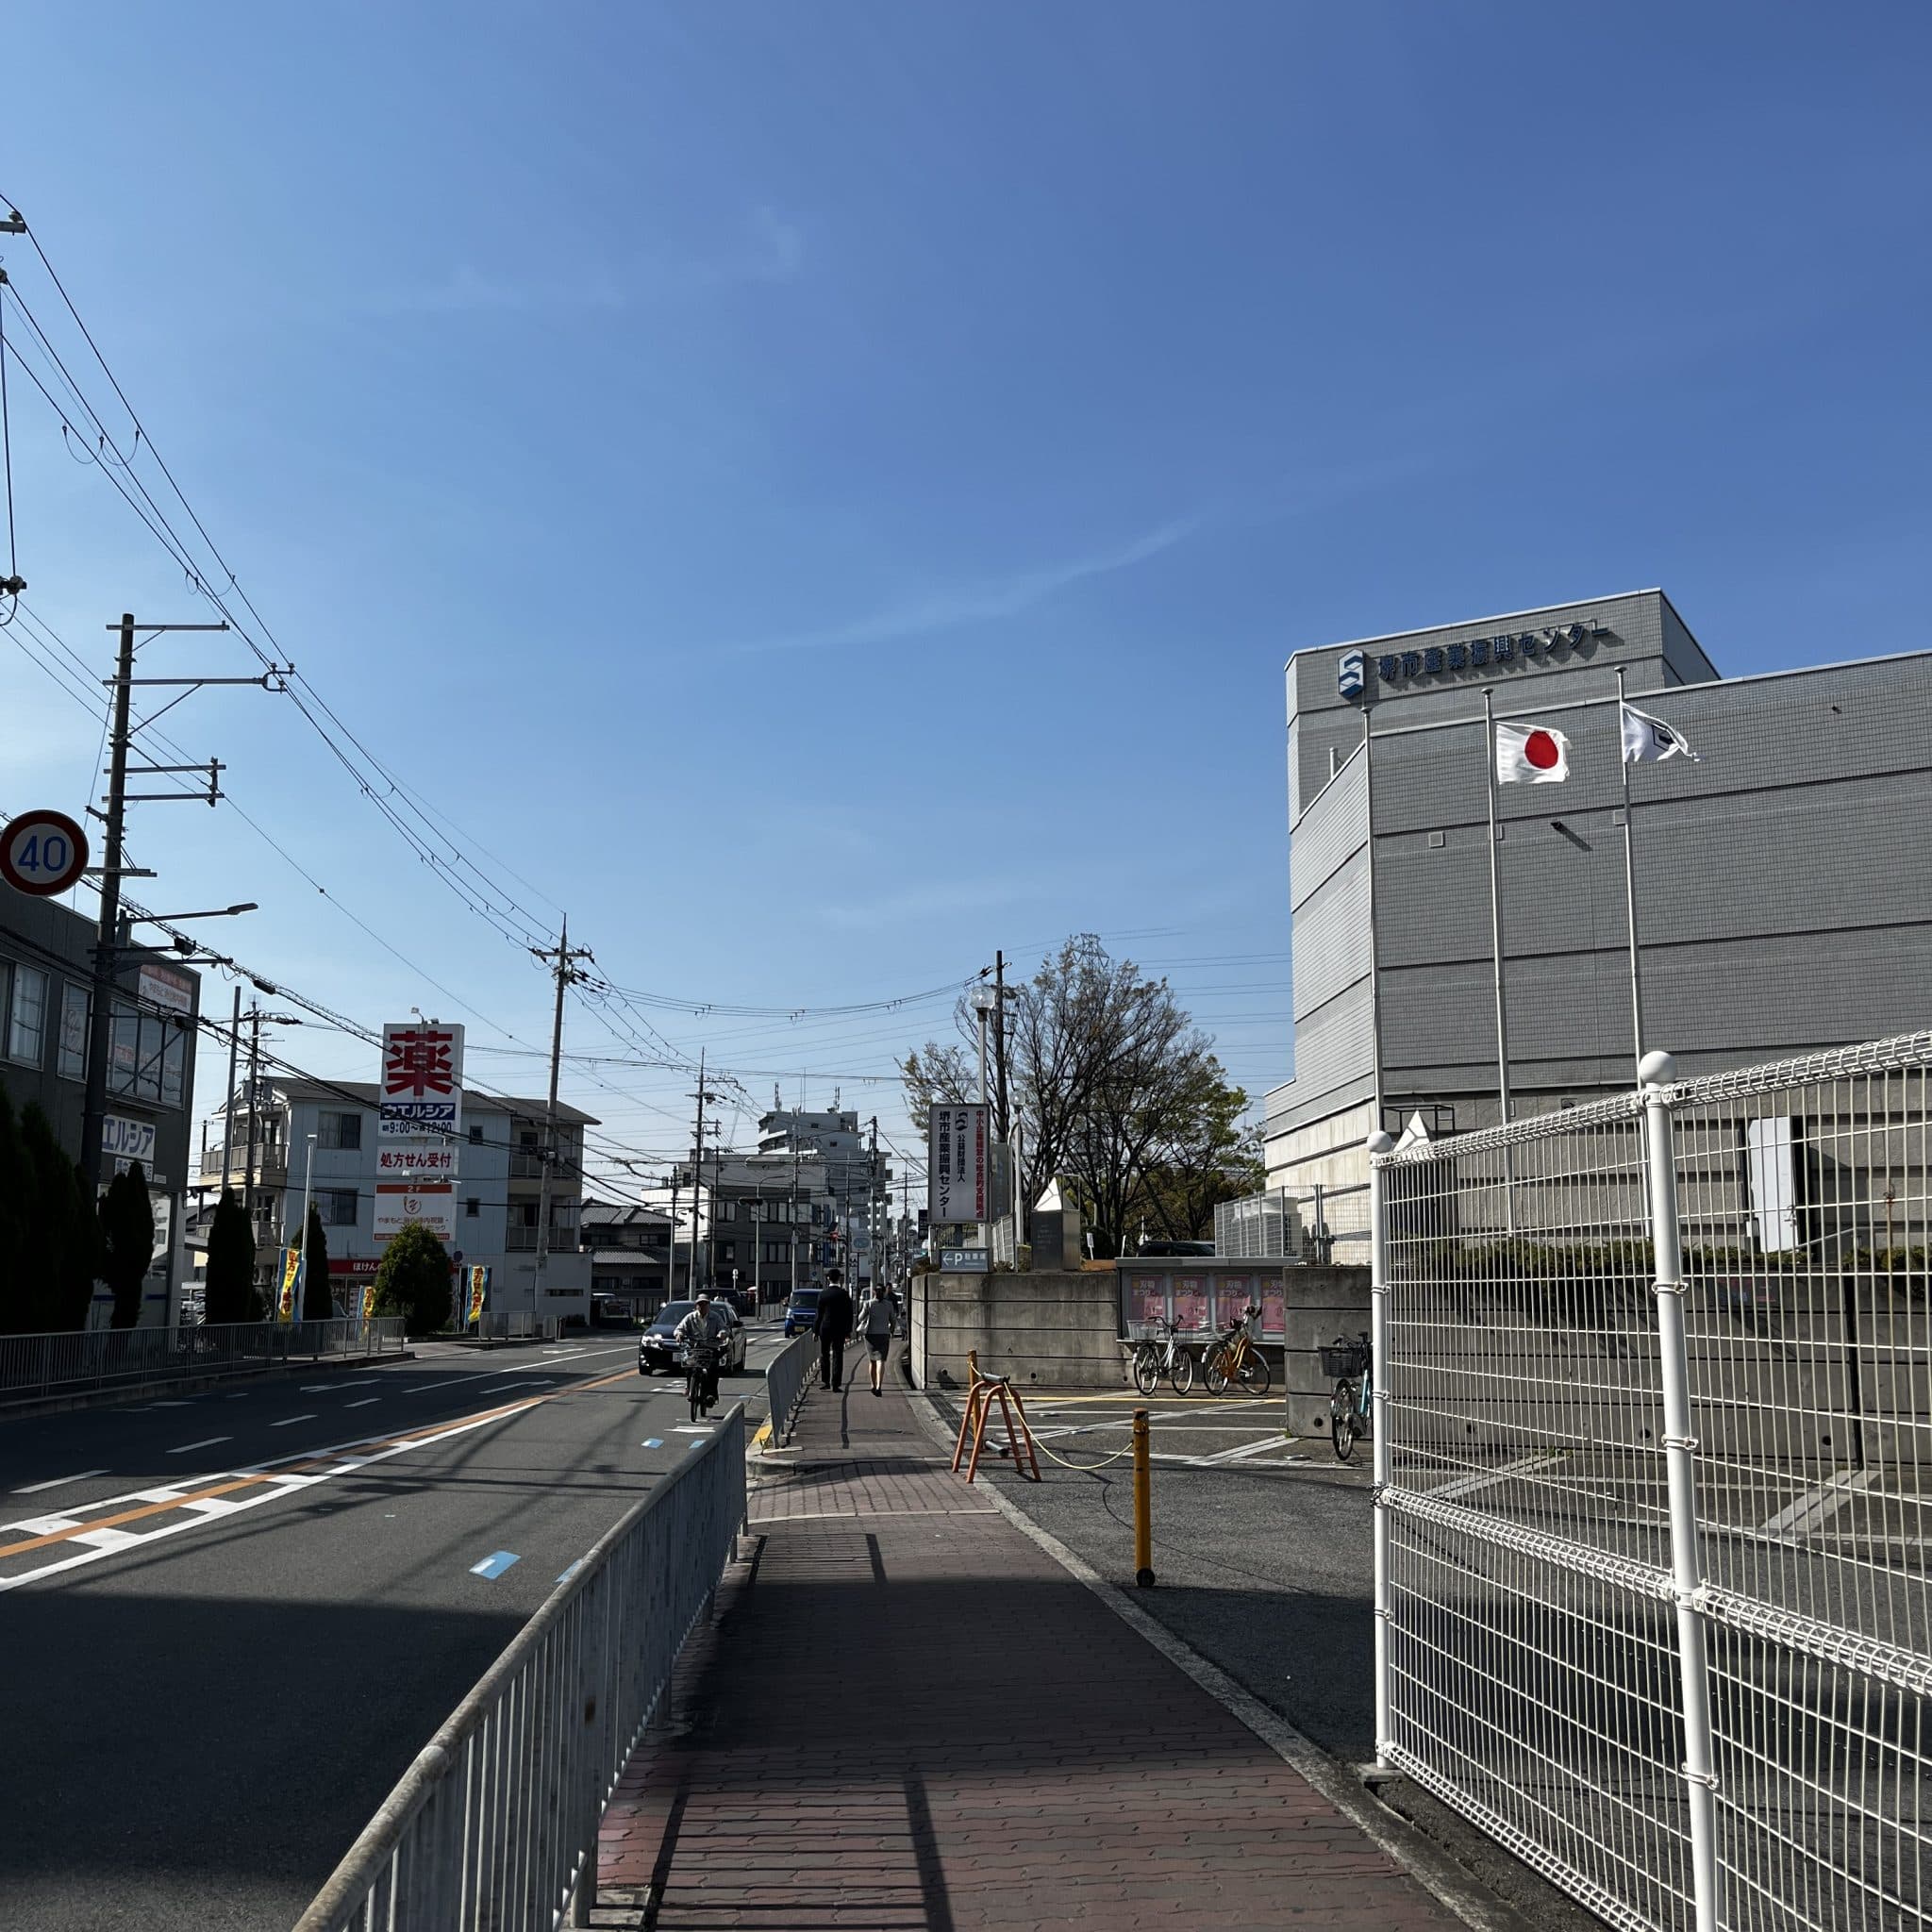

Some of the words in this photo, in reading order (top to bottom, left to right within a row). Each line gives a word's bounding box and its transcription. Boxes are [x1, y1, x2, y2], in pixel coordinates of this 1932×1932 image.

[1378, 624, 1608, 680] 堺市産業振興センター
[18, 835, 66, 872] 40
[385, 1030, 453, 1096] 薬
[102, 1118, 155, 1156] エルシア
[957, 1133, 966, 1183] 公益財団法人
[380, 1152, 452, 1169] 処方せん受付
[939, 1110, 951, 1218] 堺市産業振興センター
[955, 1253, 962, 1265] P
